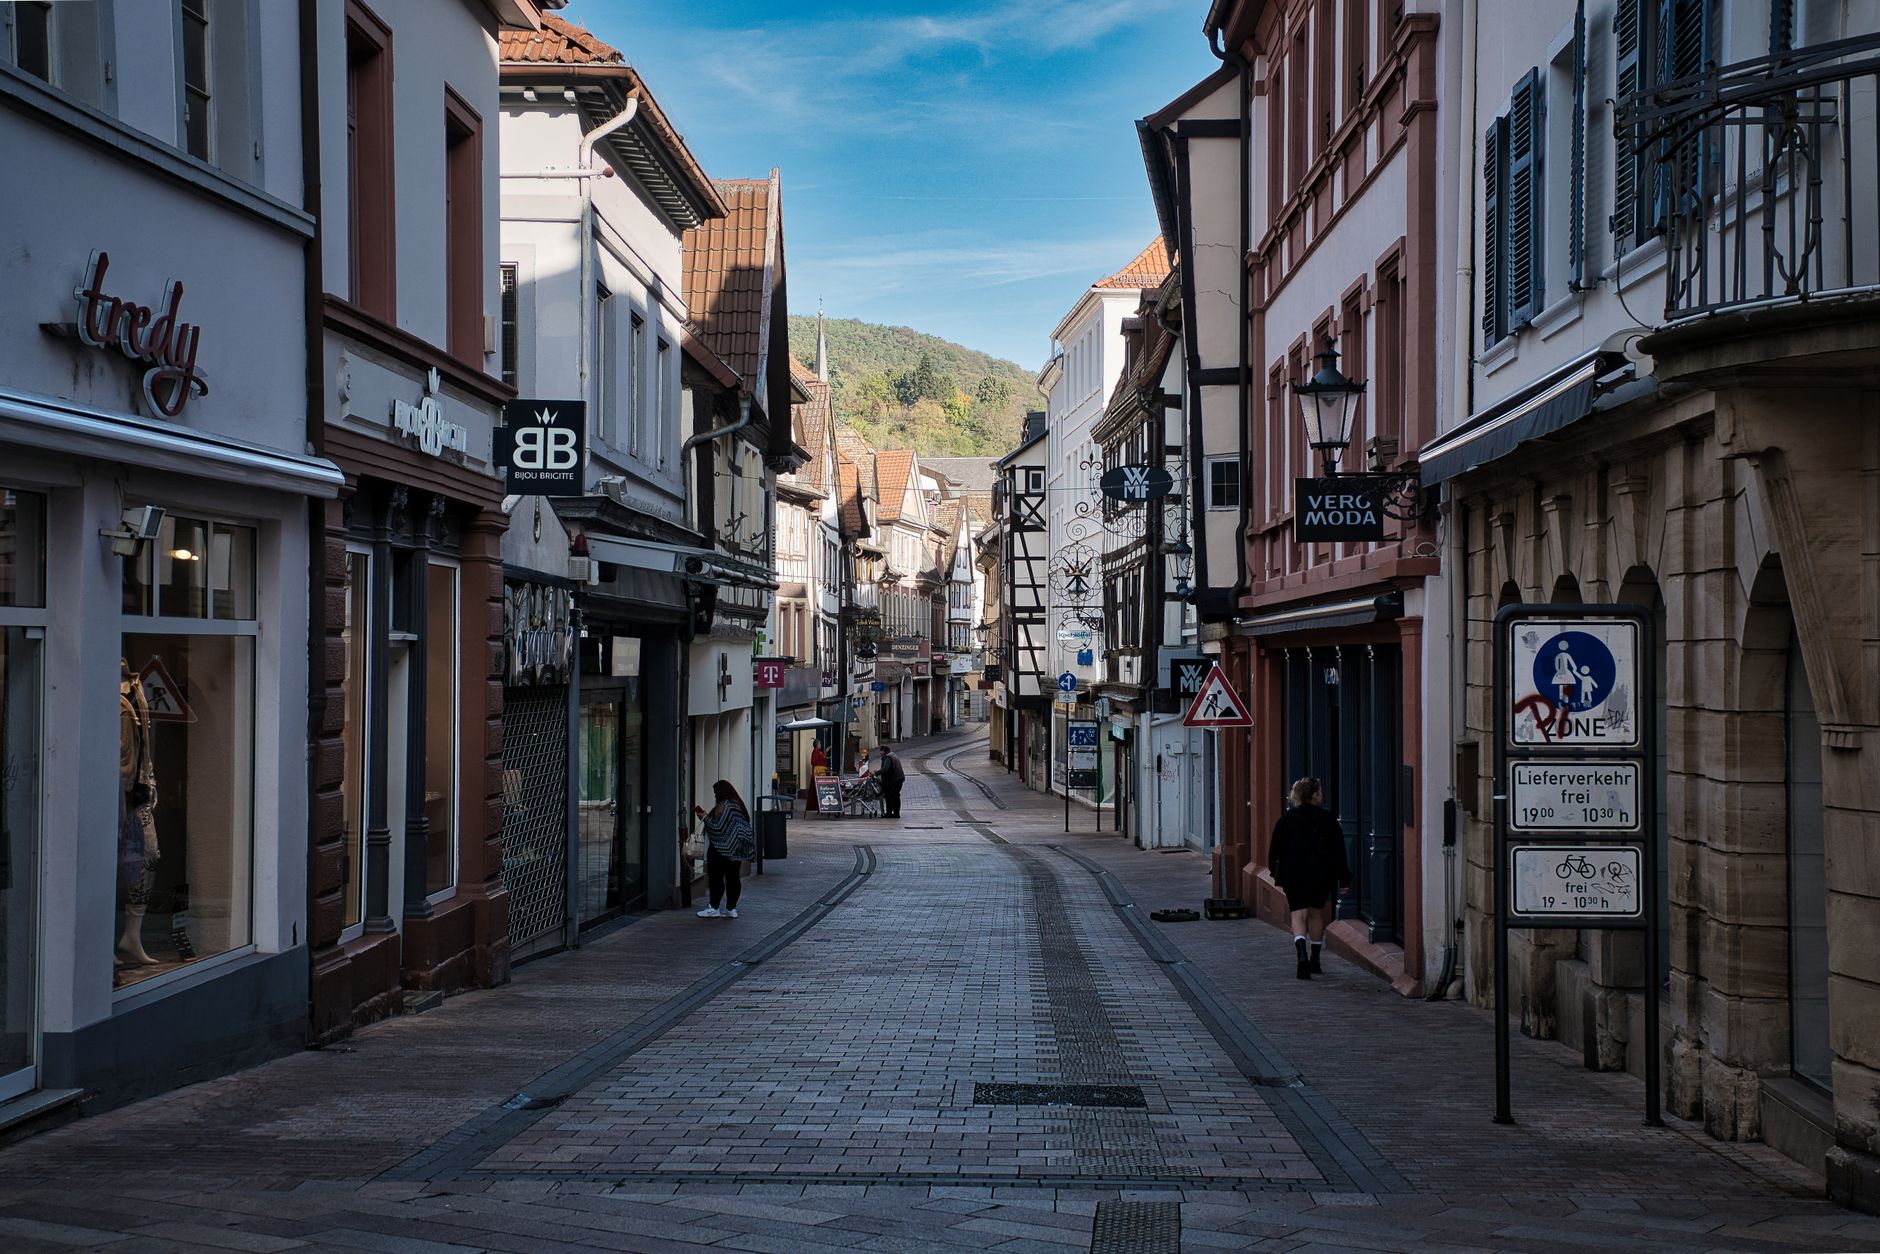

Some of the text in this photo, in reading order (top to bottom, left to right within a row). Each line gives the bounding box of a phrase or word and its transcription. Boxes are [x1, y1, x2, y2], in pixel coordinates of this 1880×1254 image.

[75, 250, 208, 418] tredy
[514, 471, 574, 481] BIJOU BRIGITTE
[1304, 510, 1377, 526] MODA
[1546, 717, 1606, 737] ZONE
[1518, 771, 1632, 785] Lieferverkehr
[1561, 789, 1590, 804] frei
[1619, 808, 1629, 822] h
[1565, 882, 1587, 893] frei
[1542, 896, 1555, 908] 19
[1601, 896, 1609, 908] h
